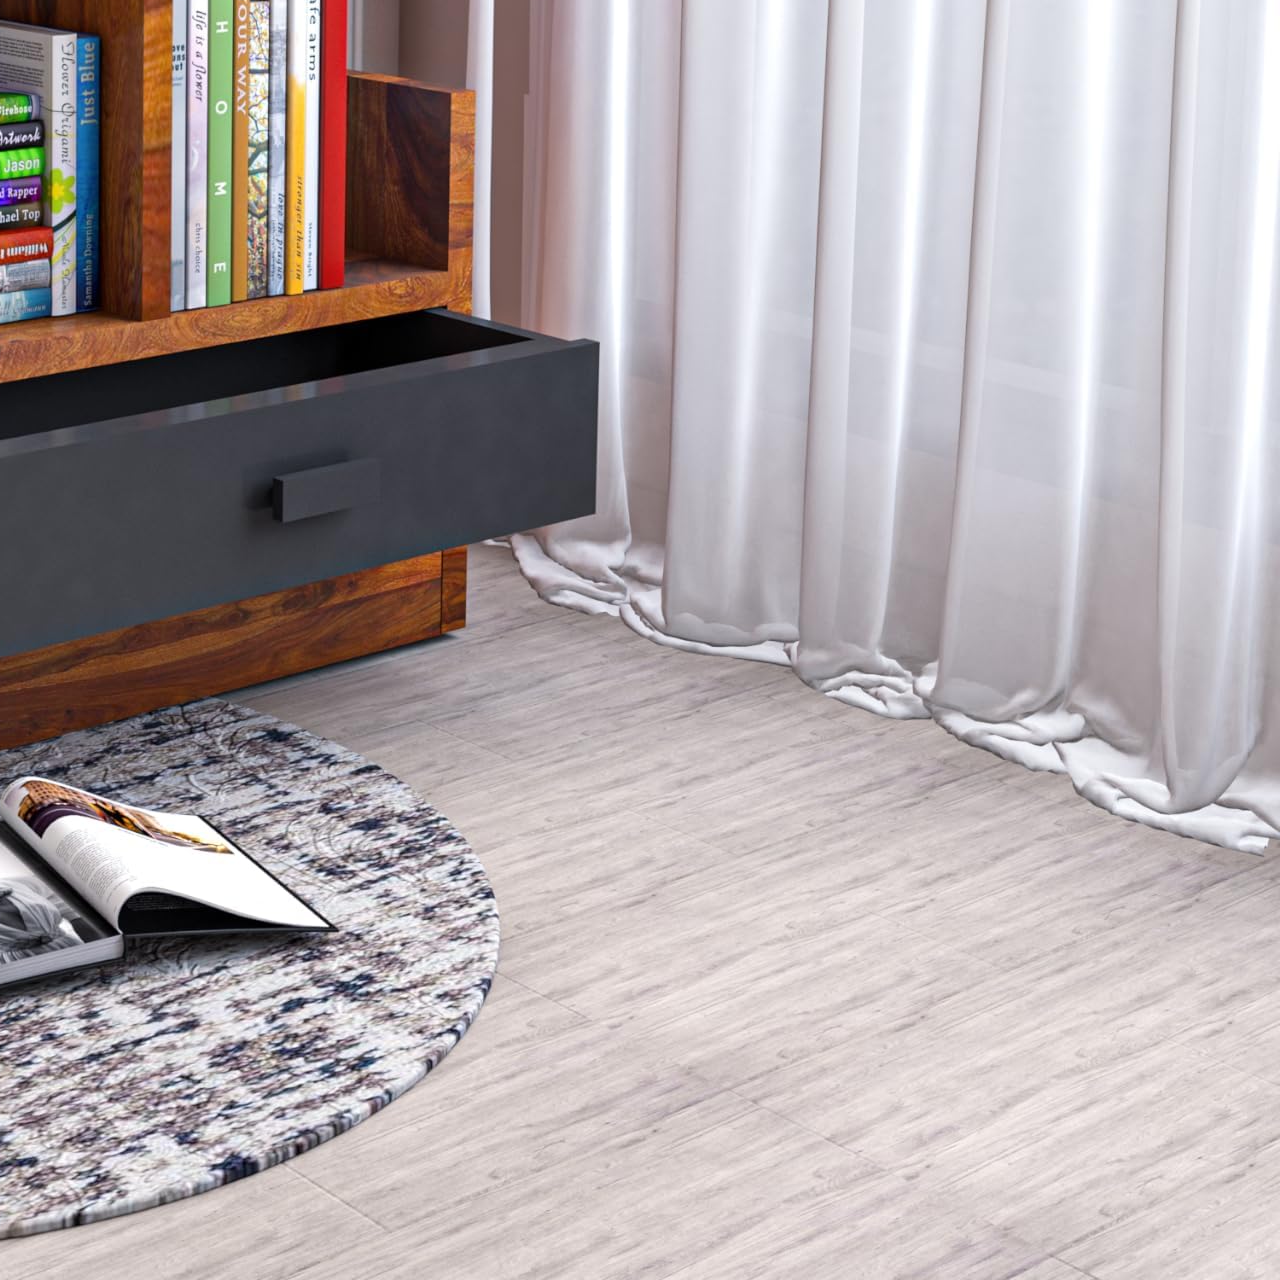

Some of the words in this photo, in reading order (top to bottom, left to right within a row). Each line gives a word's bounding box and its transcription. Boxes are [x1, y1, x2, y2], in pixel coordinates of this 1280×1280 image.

[192, 10, 207, 31] life
[195, 35, 204, 46] is
[195, 51, 202, 60] a
[61, 41, 75, 97] Flower
[81, 42, 95, 82] Blue
[309, 34, 317, 81] arms
[192, 61, 207, 103] flower
[237, 66, 247, 115] WAY
[81, 88, 97, 125] Just
[56, 102, 75, 165] Origami
[4, 158, 40, 173] Jason
[8, 186, 38, 201] Rapper
[22, 208, 41, 222] Top
[6, 242, 49, 257] William
[83, 214, 93, 256] Downing
[195, 223, 203, 244] chris
[195, 246, 203, 273] choice
[84, 259, 93, 306] Samantha
